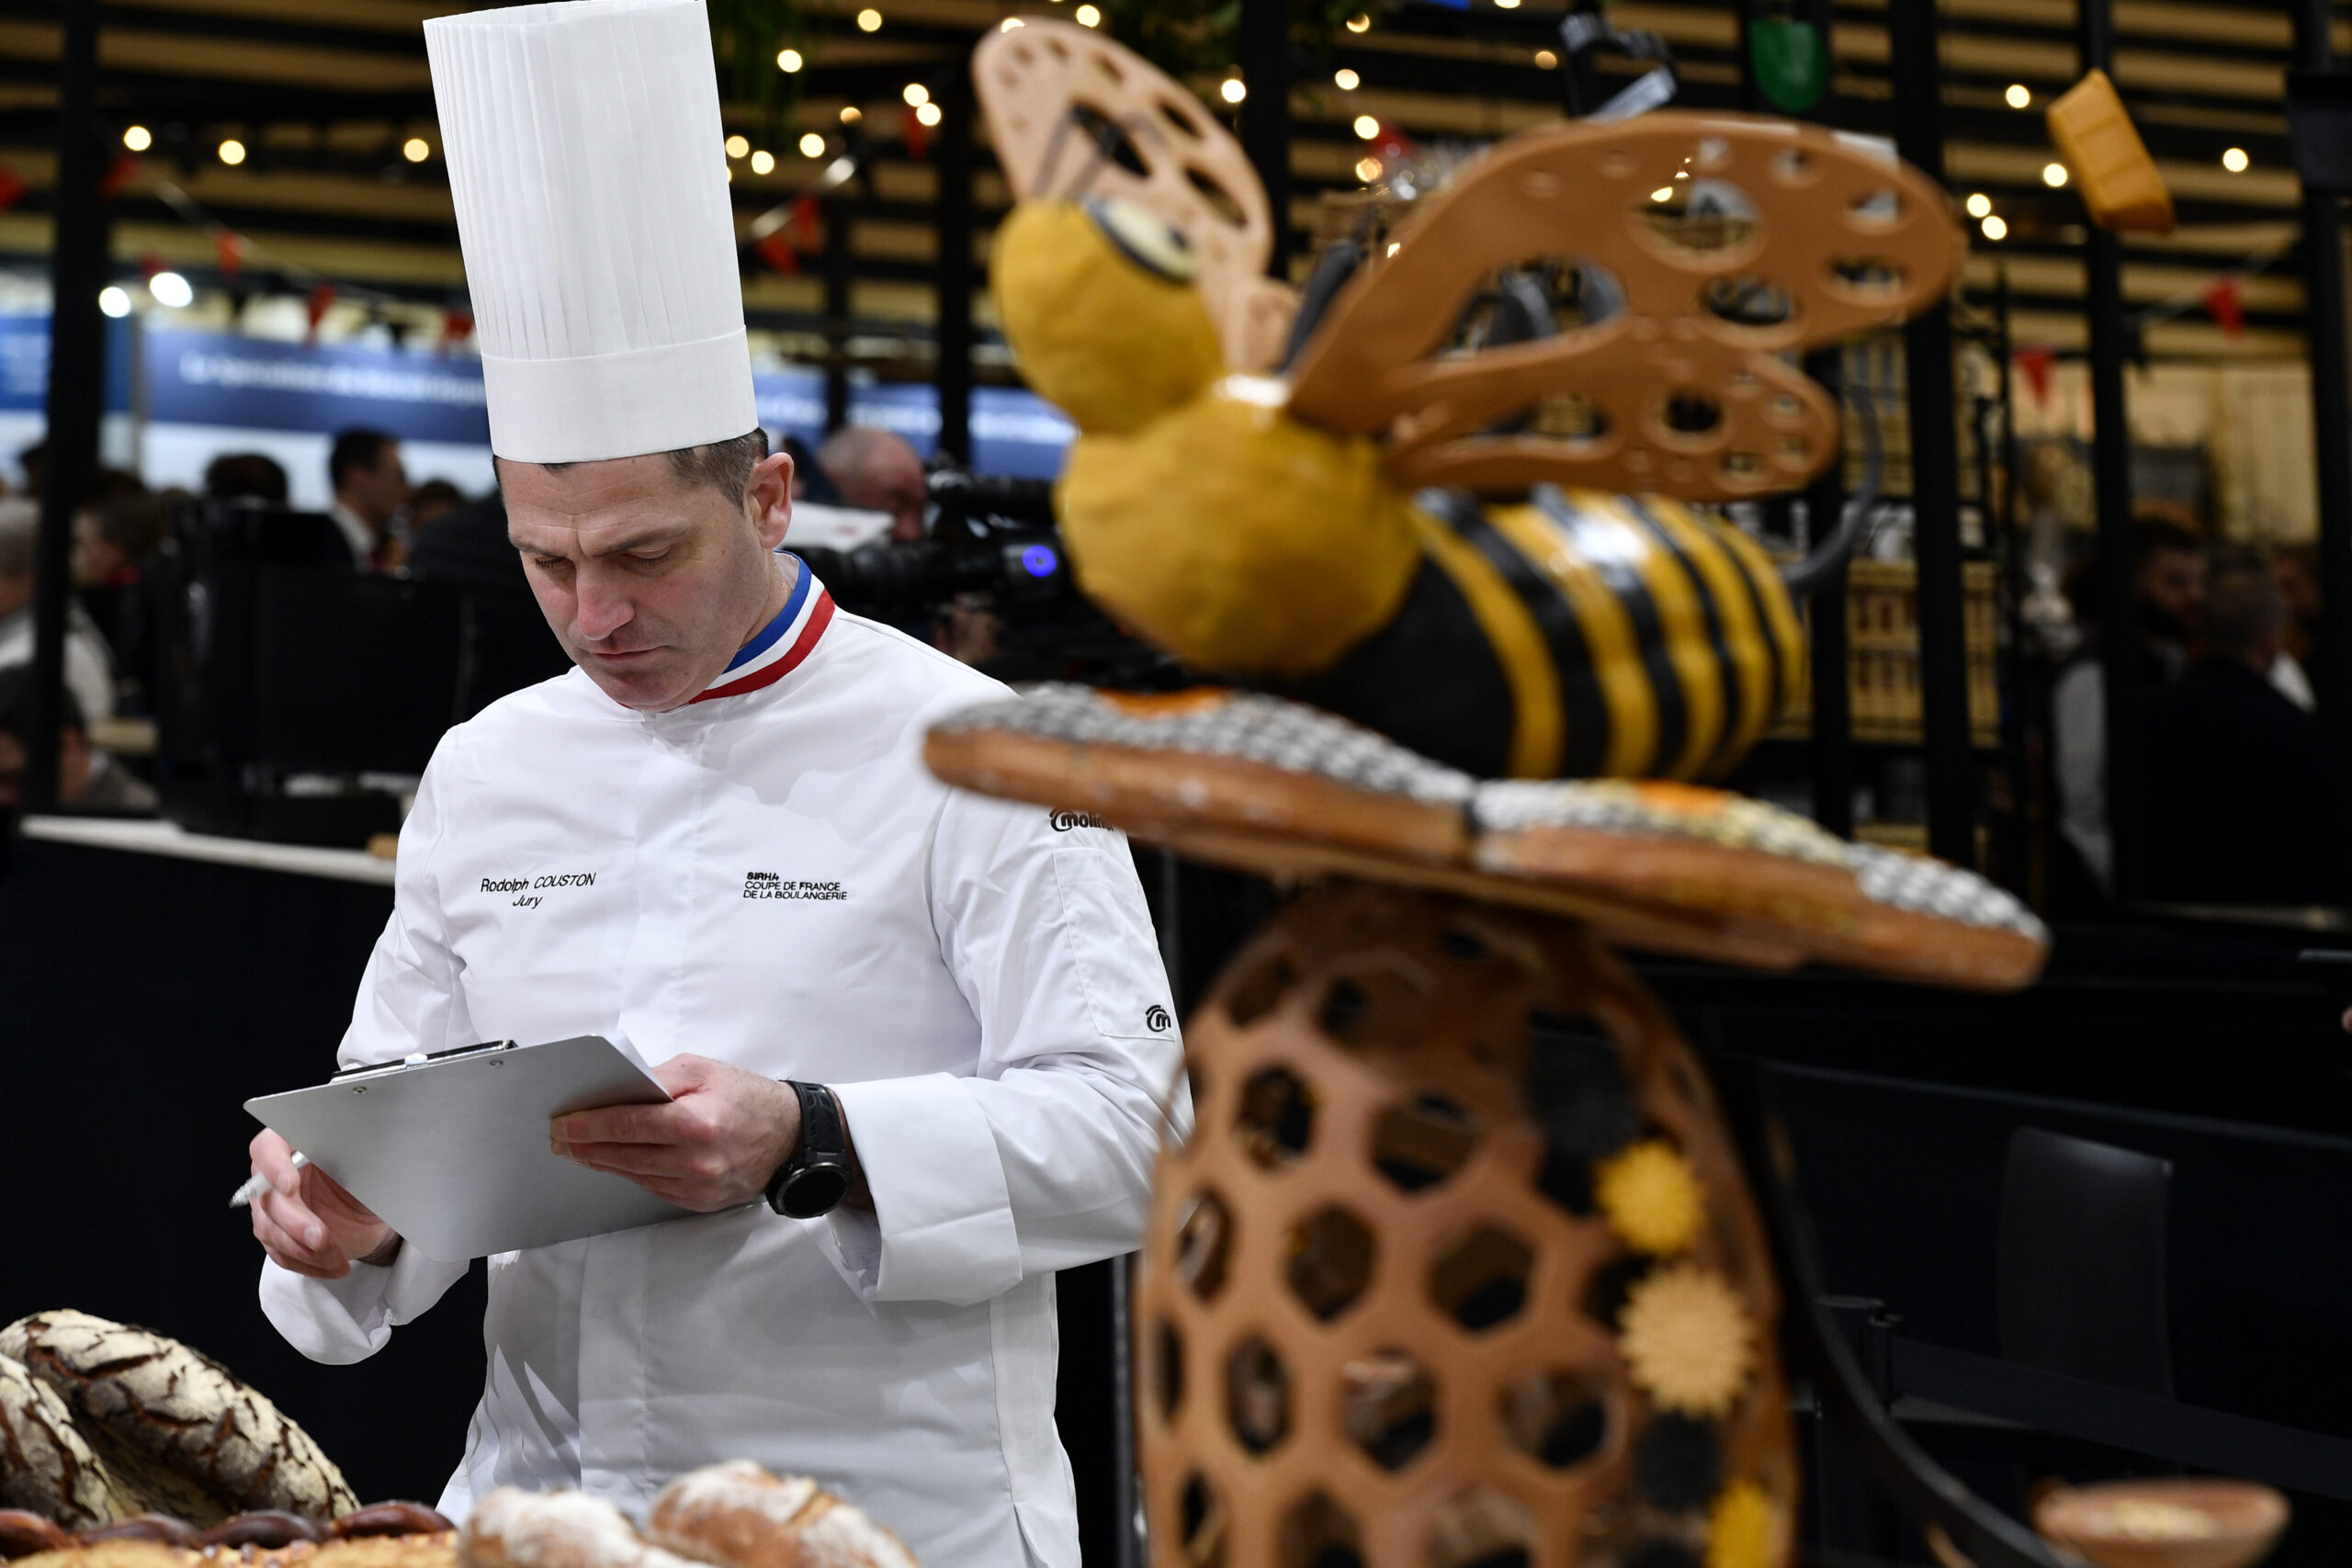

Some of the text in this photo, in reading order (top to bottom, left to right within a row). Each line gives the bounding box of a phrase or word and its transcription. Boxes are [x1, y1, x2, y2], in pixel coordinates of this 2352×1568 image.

[481, 873, 596, 894] Rodolph COUSTON
[745, 881, 841, 891] COUPE DE FRANCE
[743, 890, 847, 900] DE LA BOULANGERIE
[513, 895, 543, 909] Jury
